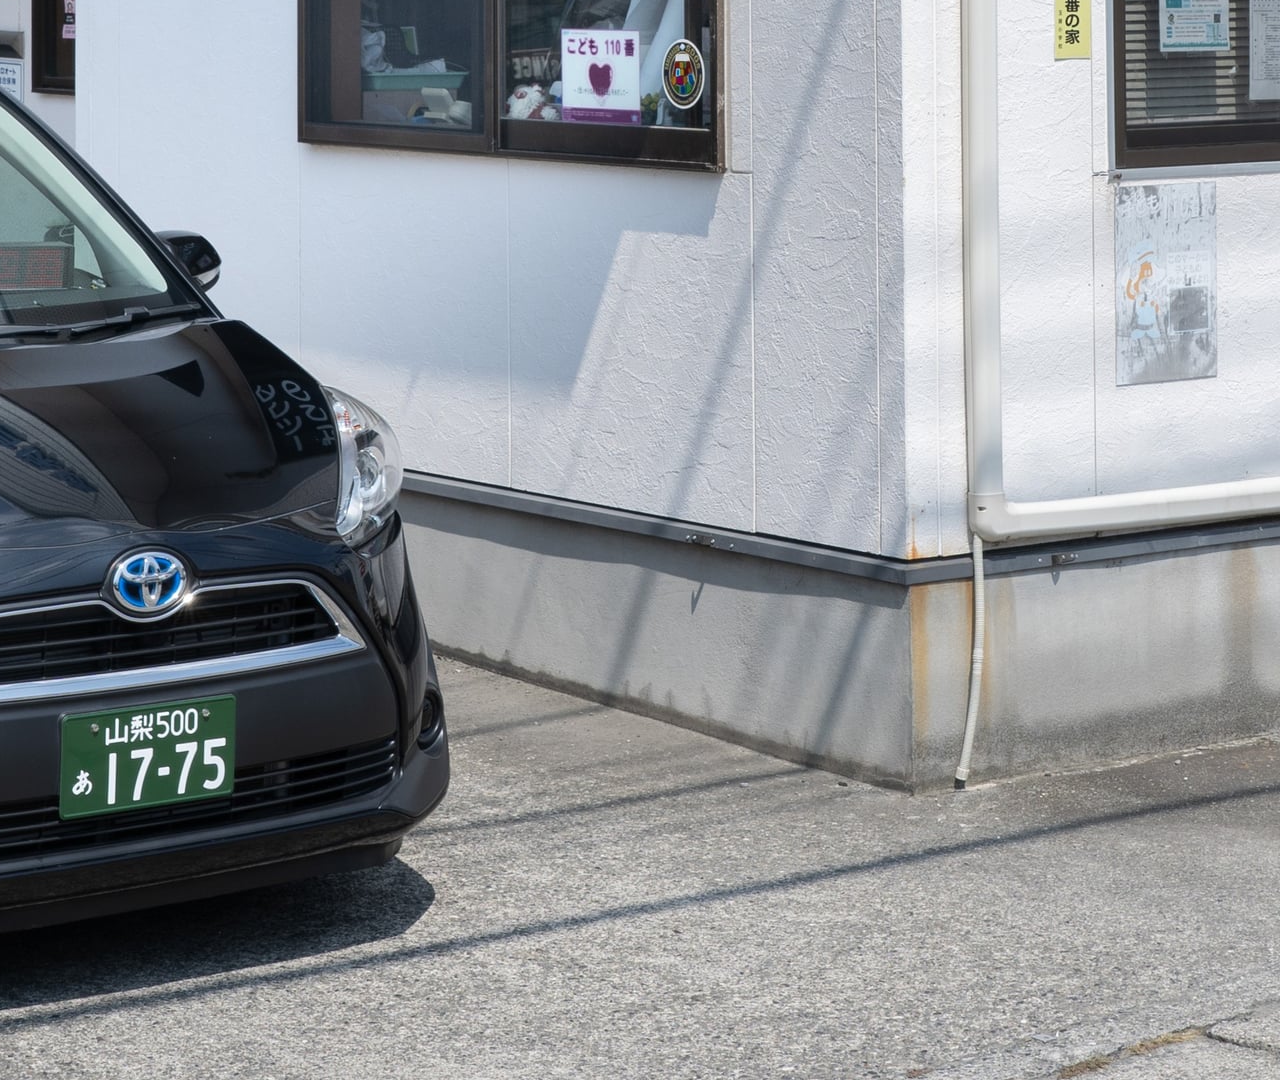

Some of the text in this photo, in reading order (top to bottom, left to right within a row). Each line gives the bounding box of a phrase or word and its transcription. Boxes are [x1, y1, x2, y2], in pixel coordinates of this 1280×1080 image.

[567, 37, 598, 56] こども
[72, 737, 227, 805] あ 17-75
